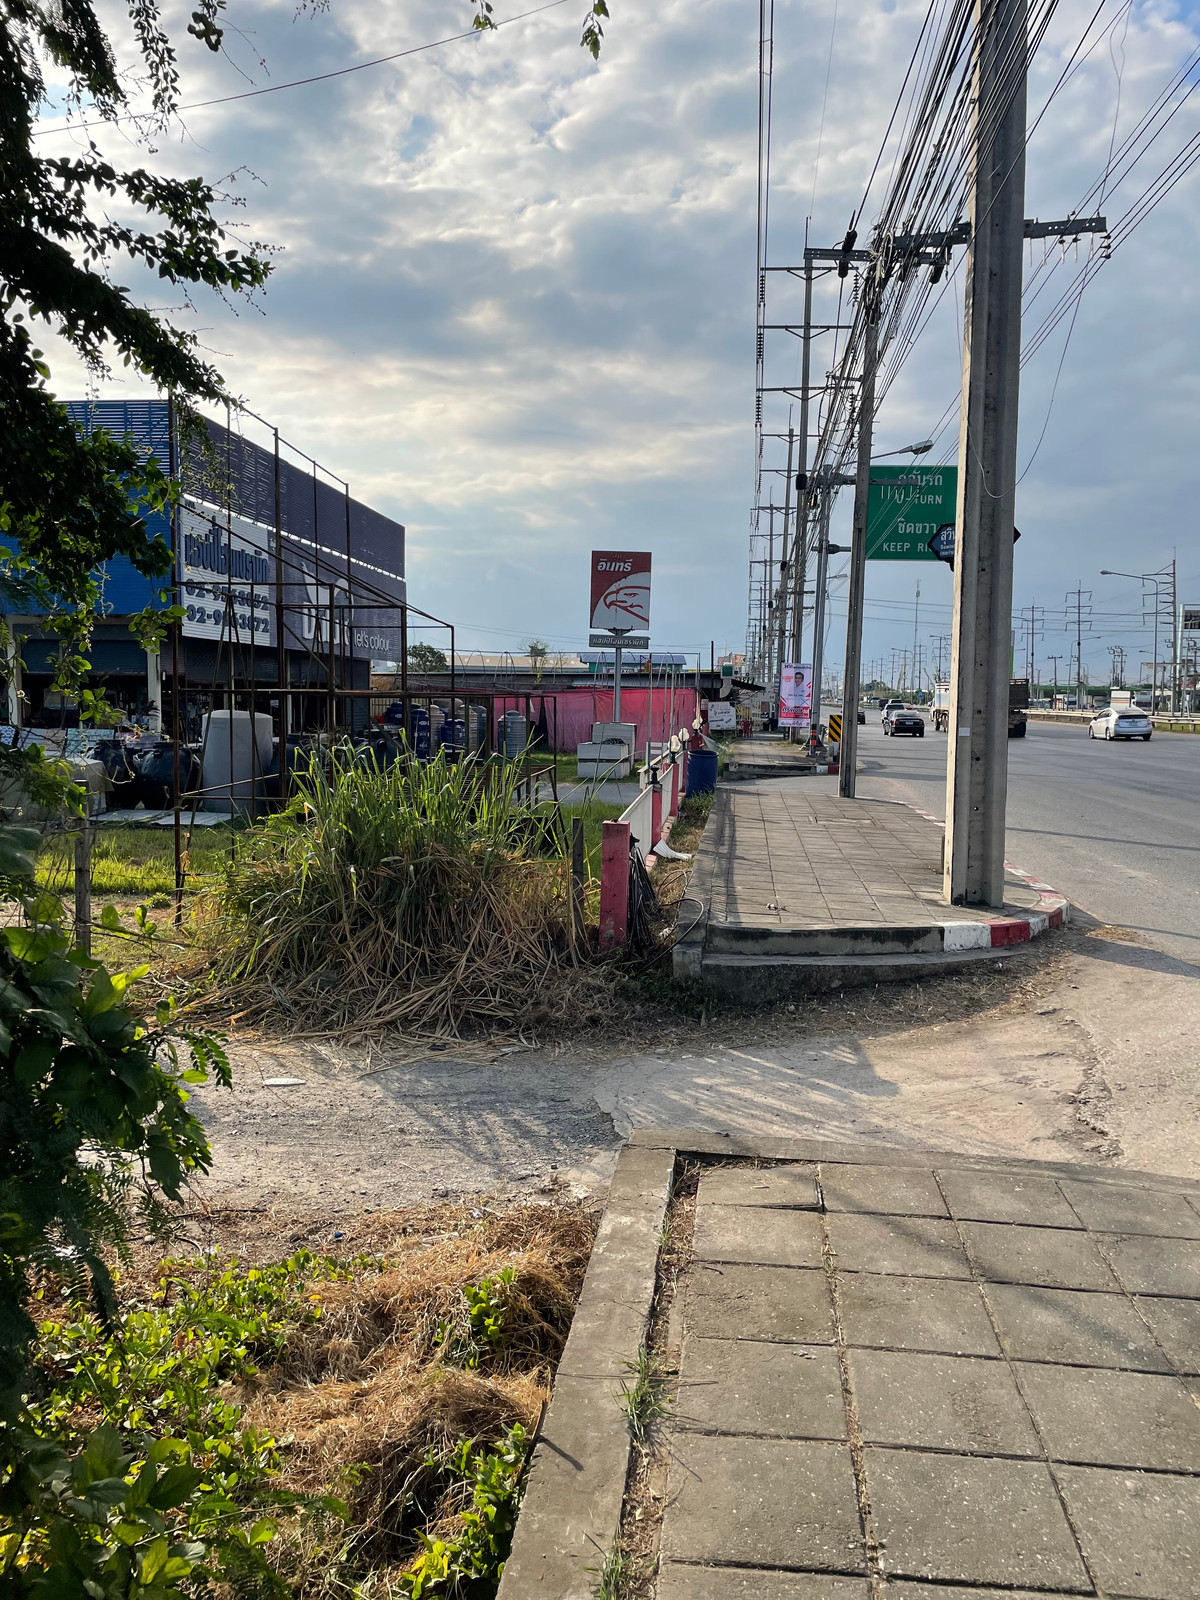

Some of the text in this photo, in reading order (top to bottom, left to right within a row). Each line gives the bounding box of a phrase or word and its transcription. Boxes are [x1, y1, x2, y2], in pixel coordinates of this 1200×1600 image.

[882, 542, 911, 552] KEEP
[597, 558, 633, 572] อินทรี
